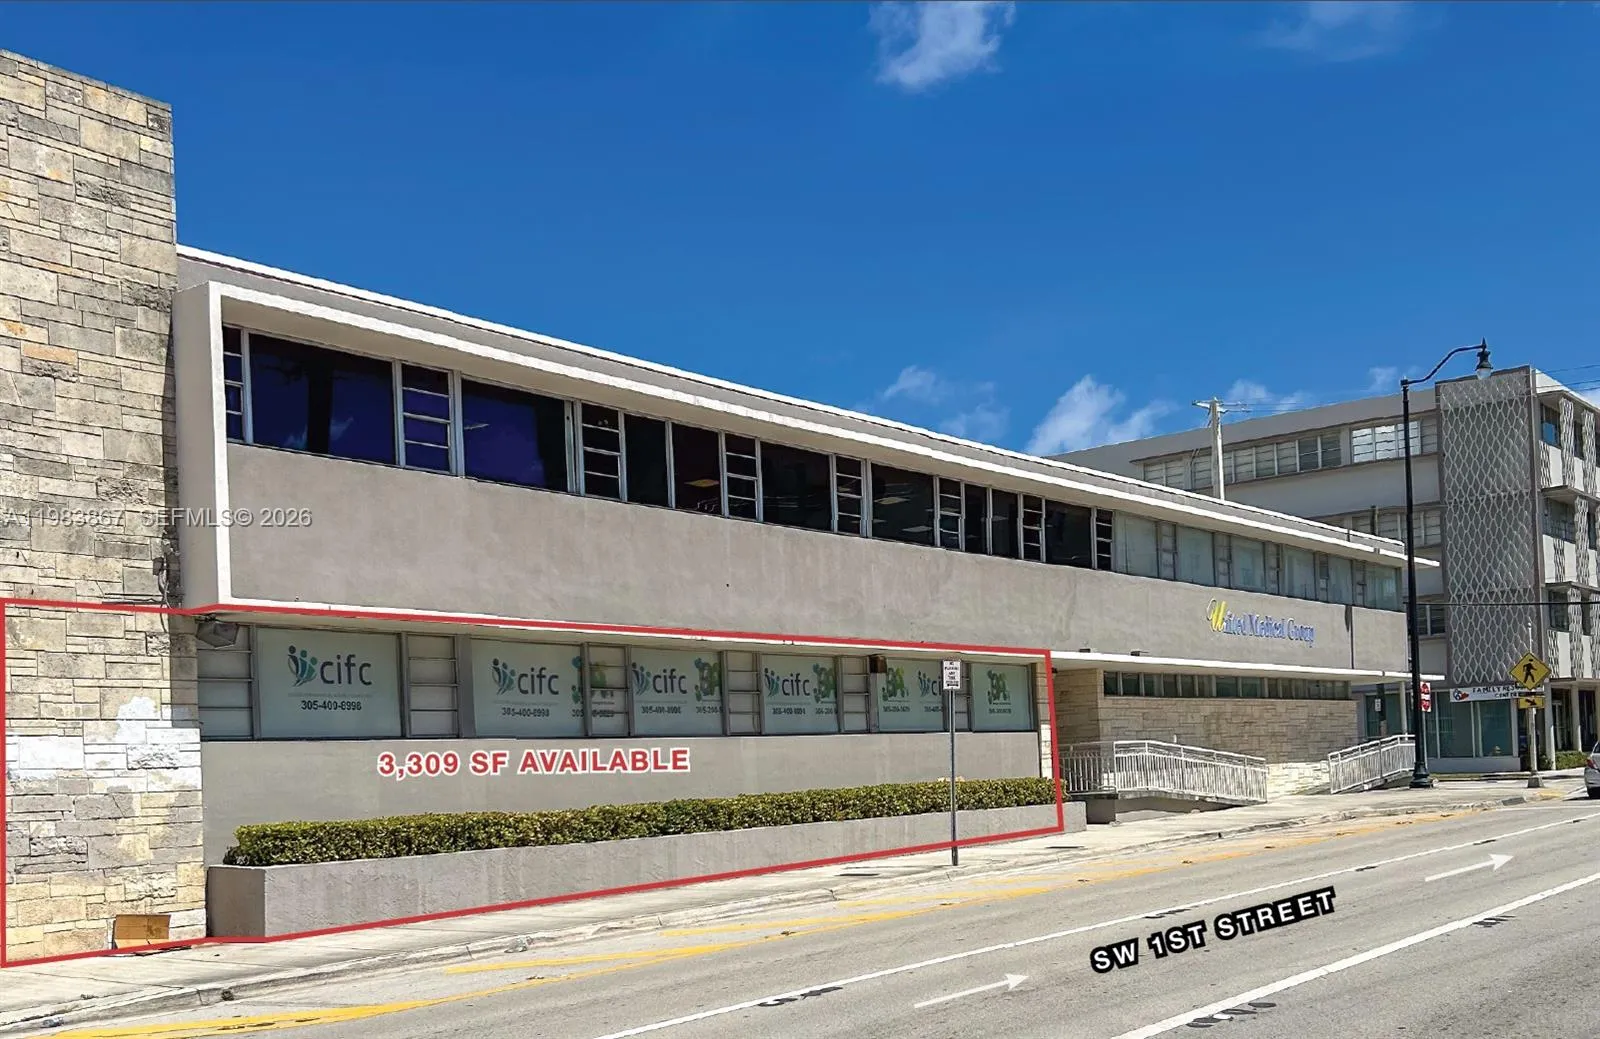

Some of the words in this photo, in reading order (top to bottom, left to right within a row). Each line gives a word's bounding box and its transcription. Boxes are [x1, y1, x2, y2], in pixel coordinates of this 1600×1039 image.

[1248, 614, 1286, 639] Medical
[1287, 617, 1316, 648] Group
[320, 654, 373, 686] cifc
[517, 667, 560, 695] cifc
[652, 668, 688, 694] cifc
[781, 673, 811, 697] cifc
